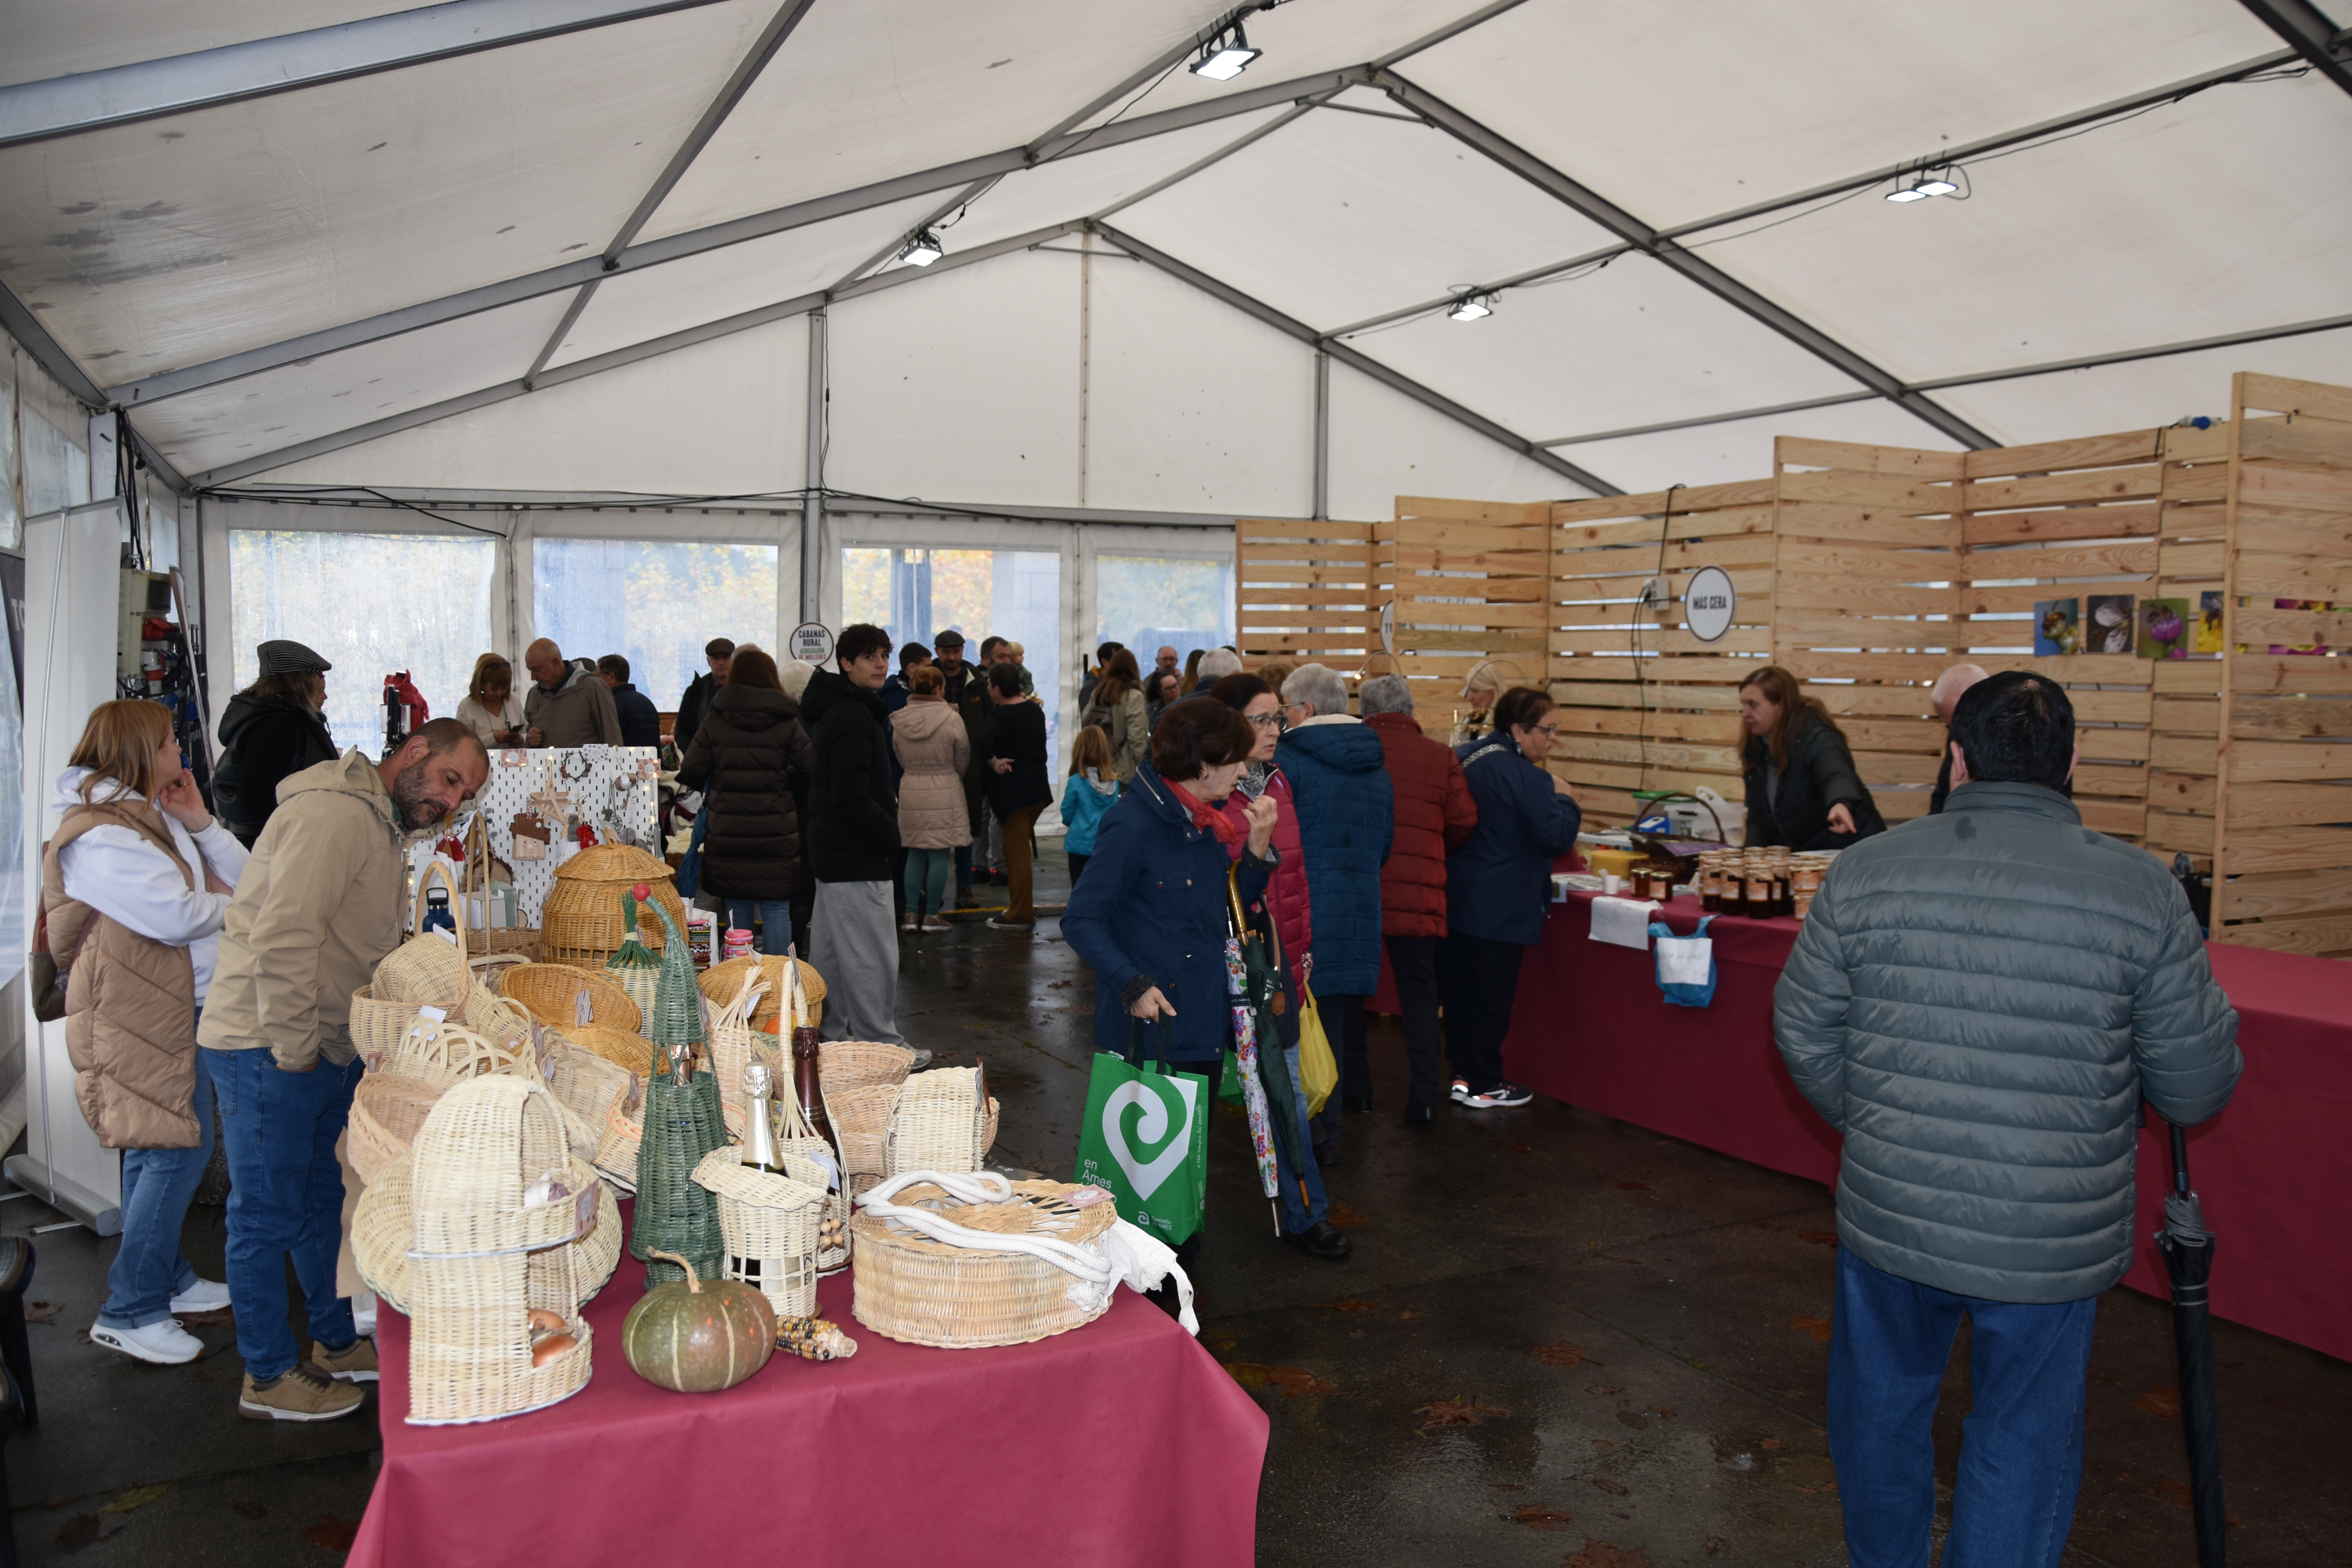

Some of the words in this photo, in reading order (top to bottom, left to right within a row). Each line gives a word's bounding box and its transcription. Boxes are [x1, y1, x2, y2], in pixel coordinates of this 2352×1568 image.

[1709, 596, 1727, 609] CERA
[798, 630, 826, 638] CABANAS
[803, 638, 821, 647] RURAL
[1084, 1159, 1098, 1171] en
[1081, 1169, 1112, 1189] Ames
[1152, 1215, 1172, 1225] Concello
